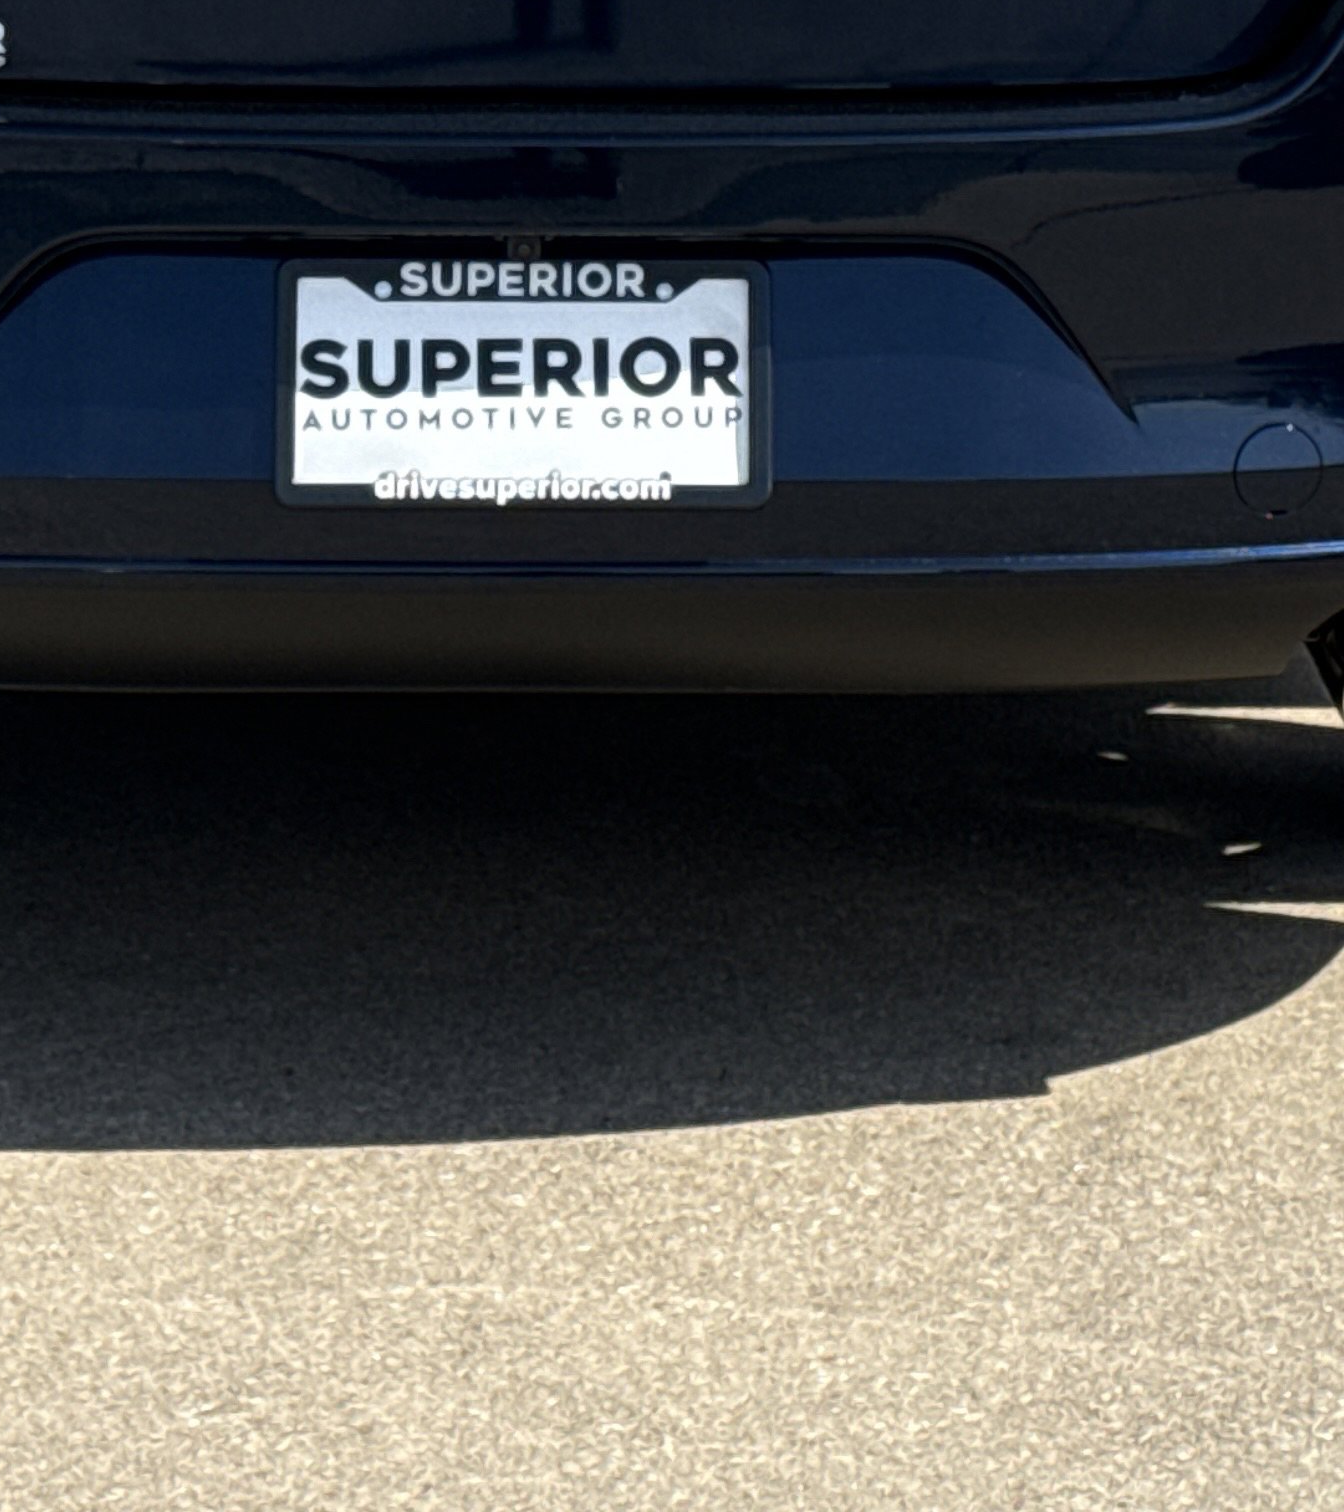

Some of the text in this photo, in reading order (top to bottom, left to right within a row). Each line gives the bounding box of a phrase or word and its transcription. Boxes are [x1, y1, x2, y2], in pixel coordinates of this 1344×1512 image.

[399, 261, 646, 298] SUPERIOR
[299, 336, 743, 400] SUPERIOR
[302, 405, 743, 432] AUTOMOTIVE GROUP
[374, 468, 672, 505] drivesuperior.com
